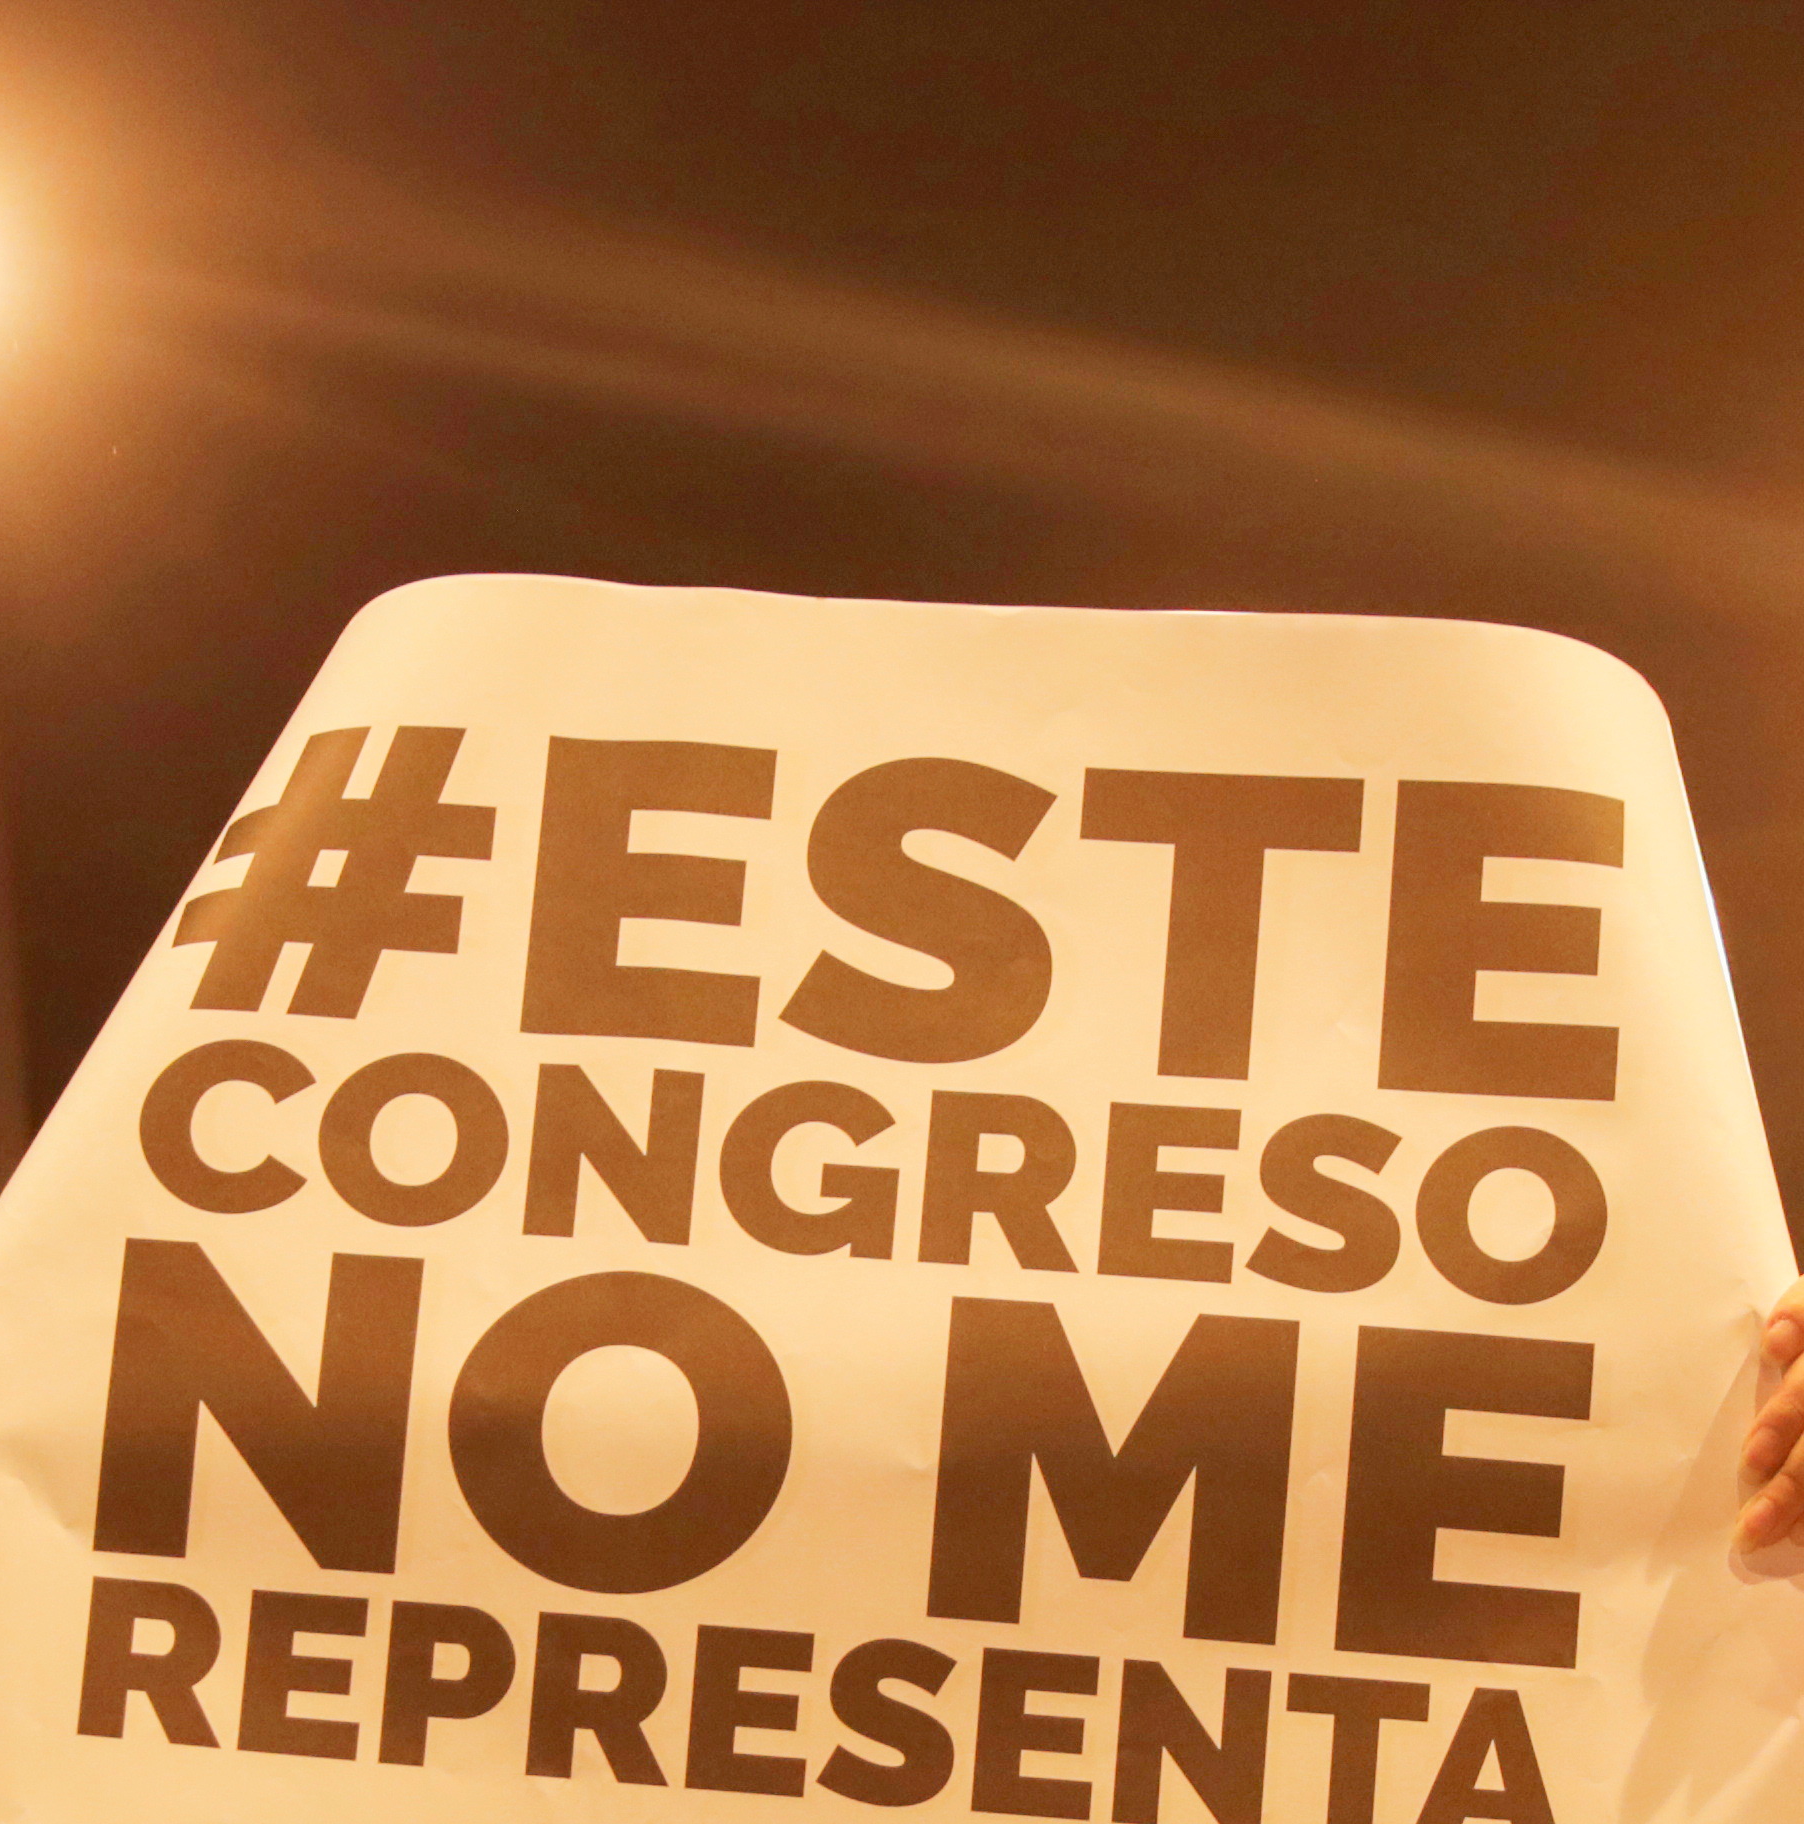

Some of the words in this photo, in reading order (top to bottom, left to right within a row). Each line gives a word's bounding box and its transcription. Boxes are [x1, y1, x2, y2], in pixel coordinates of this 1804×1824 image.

[170, 724, 1626, 1102] #ESTE
[138, 1038, 1609, 1307] CONGRESO
[91, 1237, 793, 1596] NO
[927, 1296, 1595, 1670] ME
